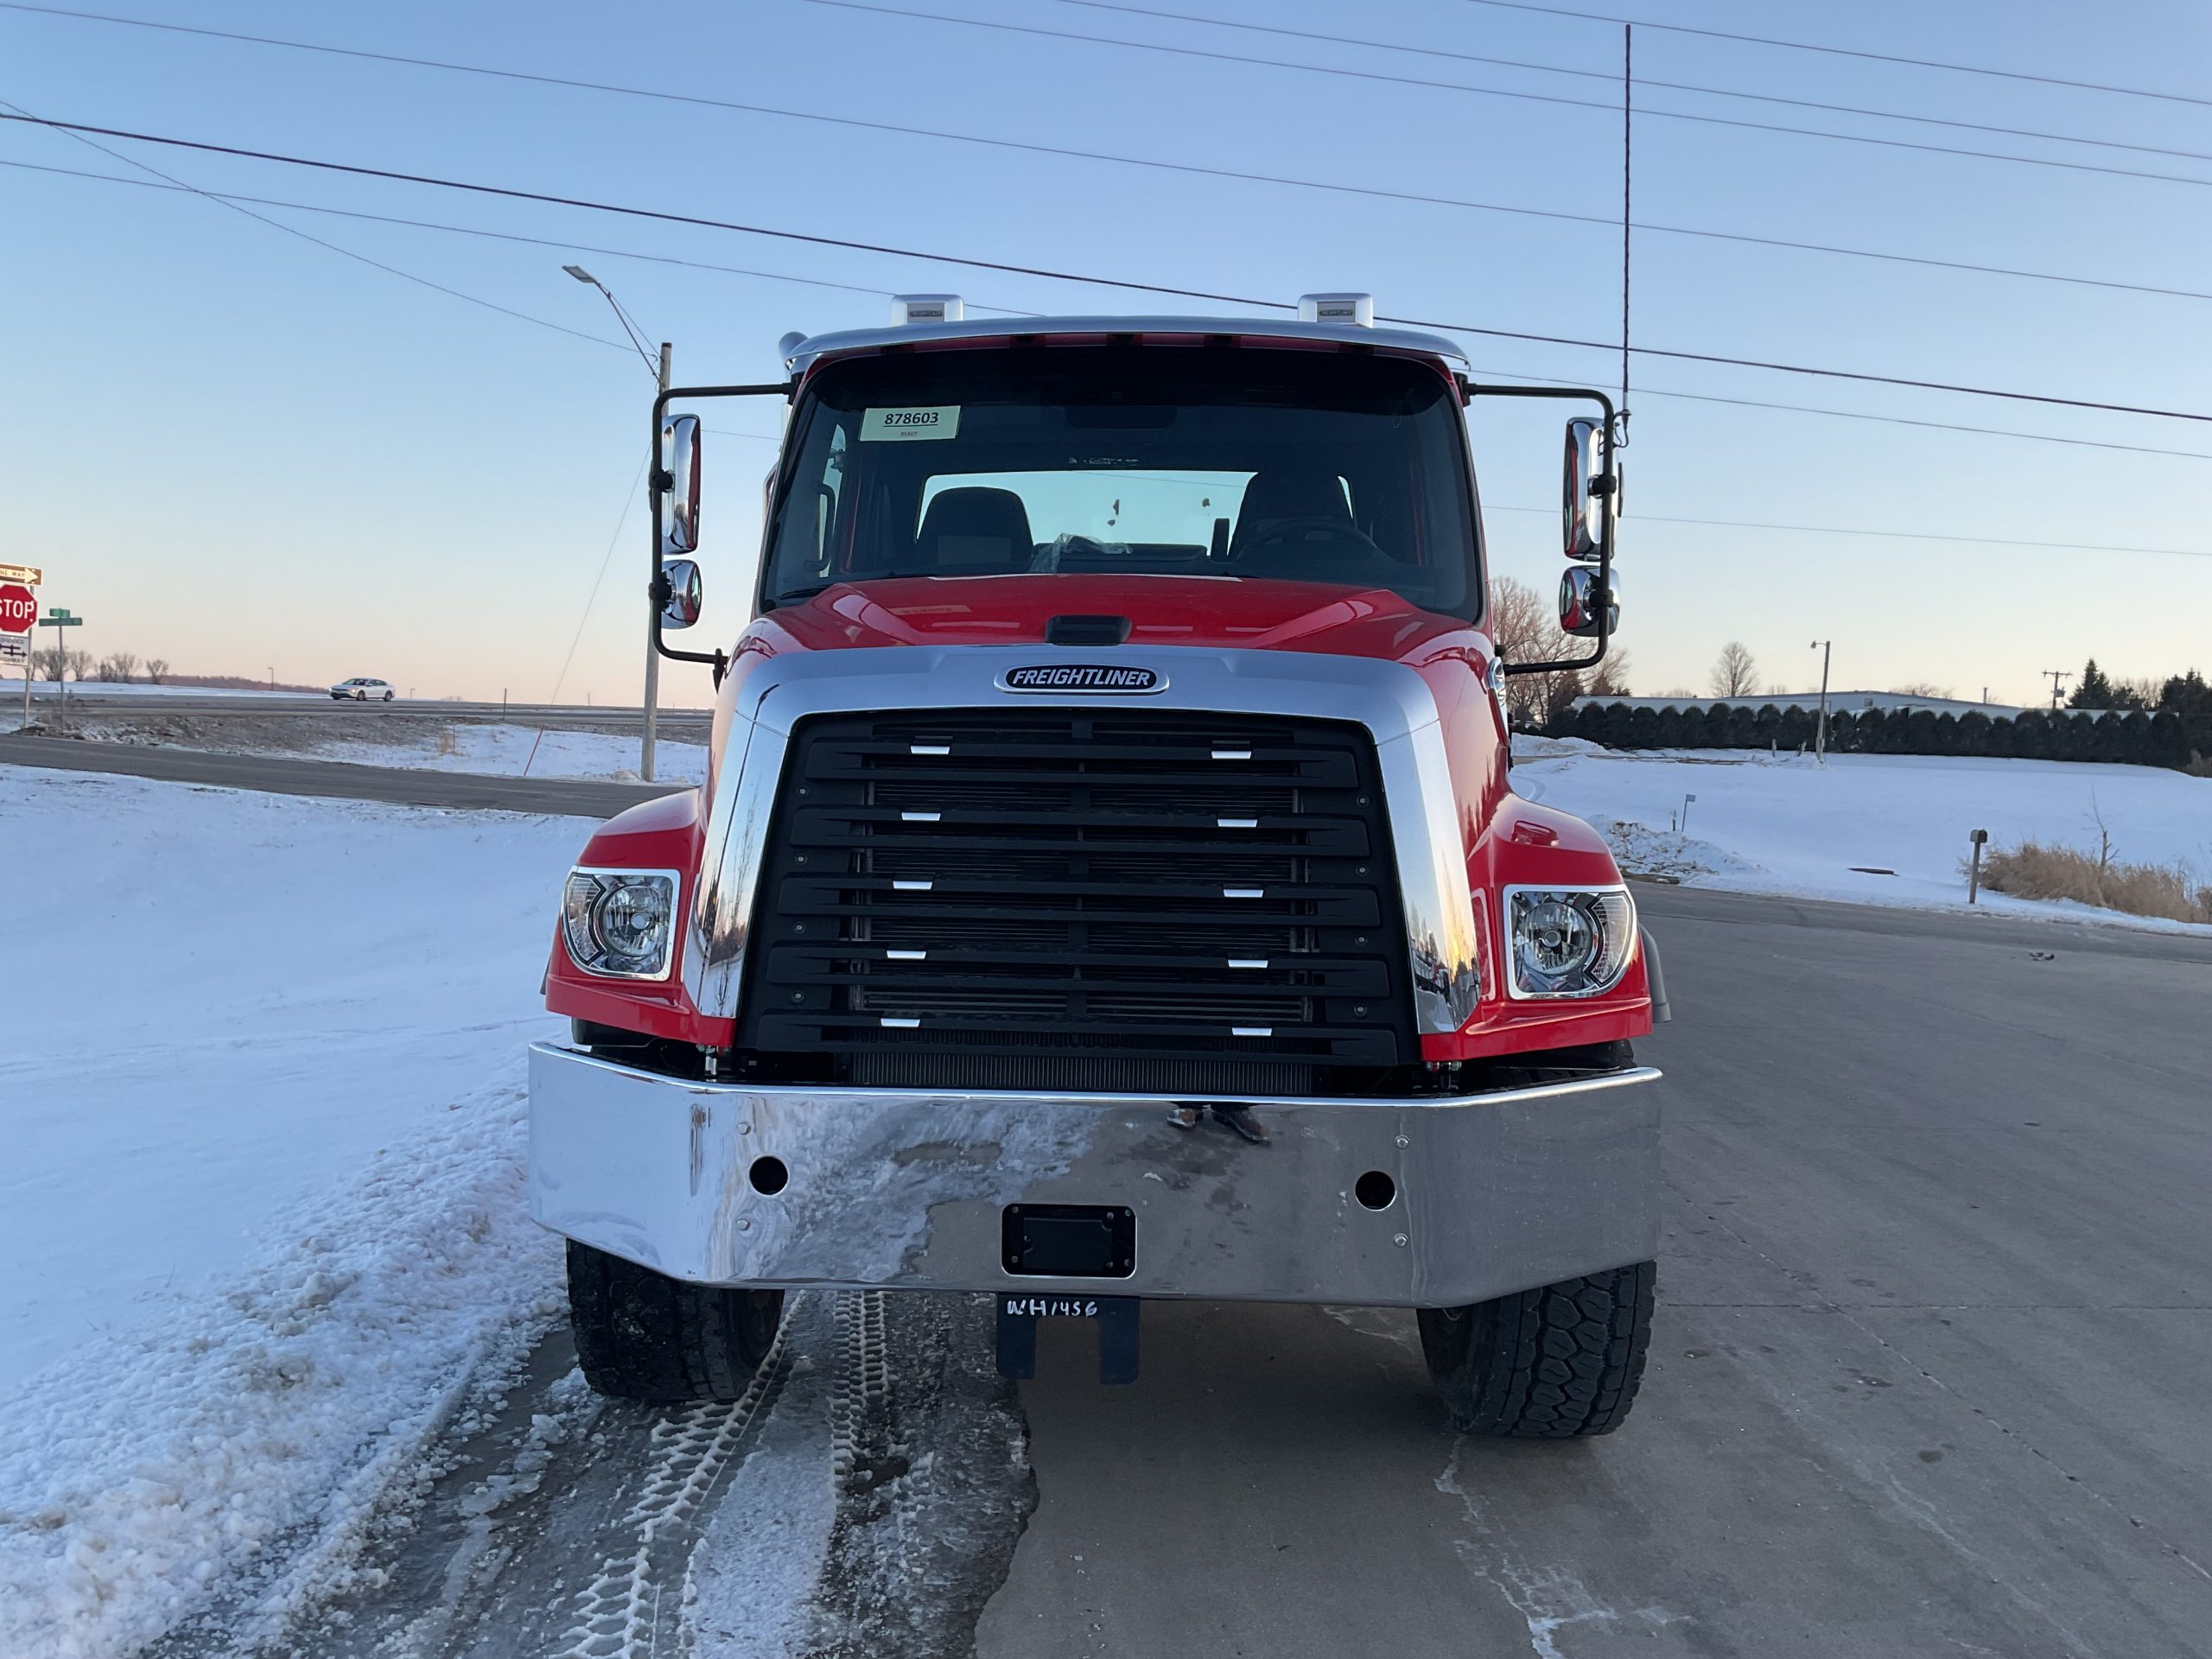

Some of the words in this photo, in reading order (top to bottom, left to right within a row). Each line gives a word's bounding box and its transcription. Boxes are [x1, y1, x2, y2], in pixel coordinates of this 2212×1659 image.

[884, 412, 939, 425] 878603
[0, 599, 35, 619] TOP
[1012, 668, 1150, 685] FREIGHTLINER
